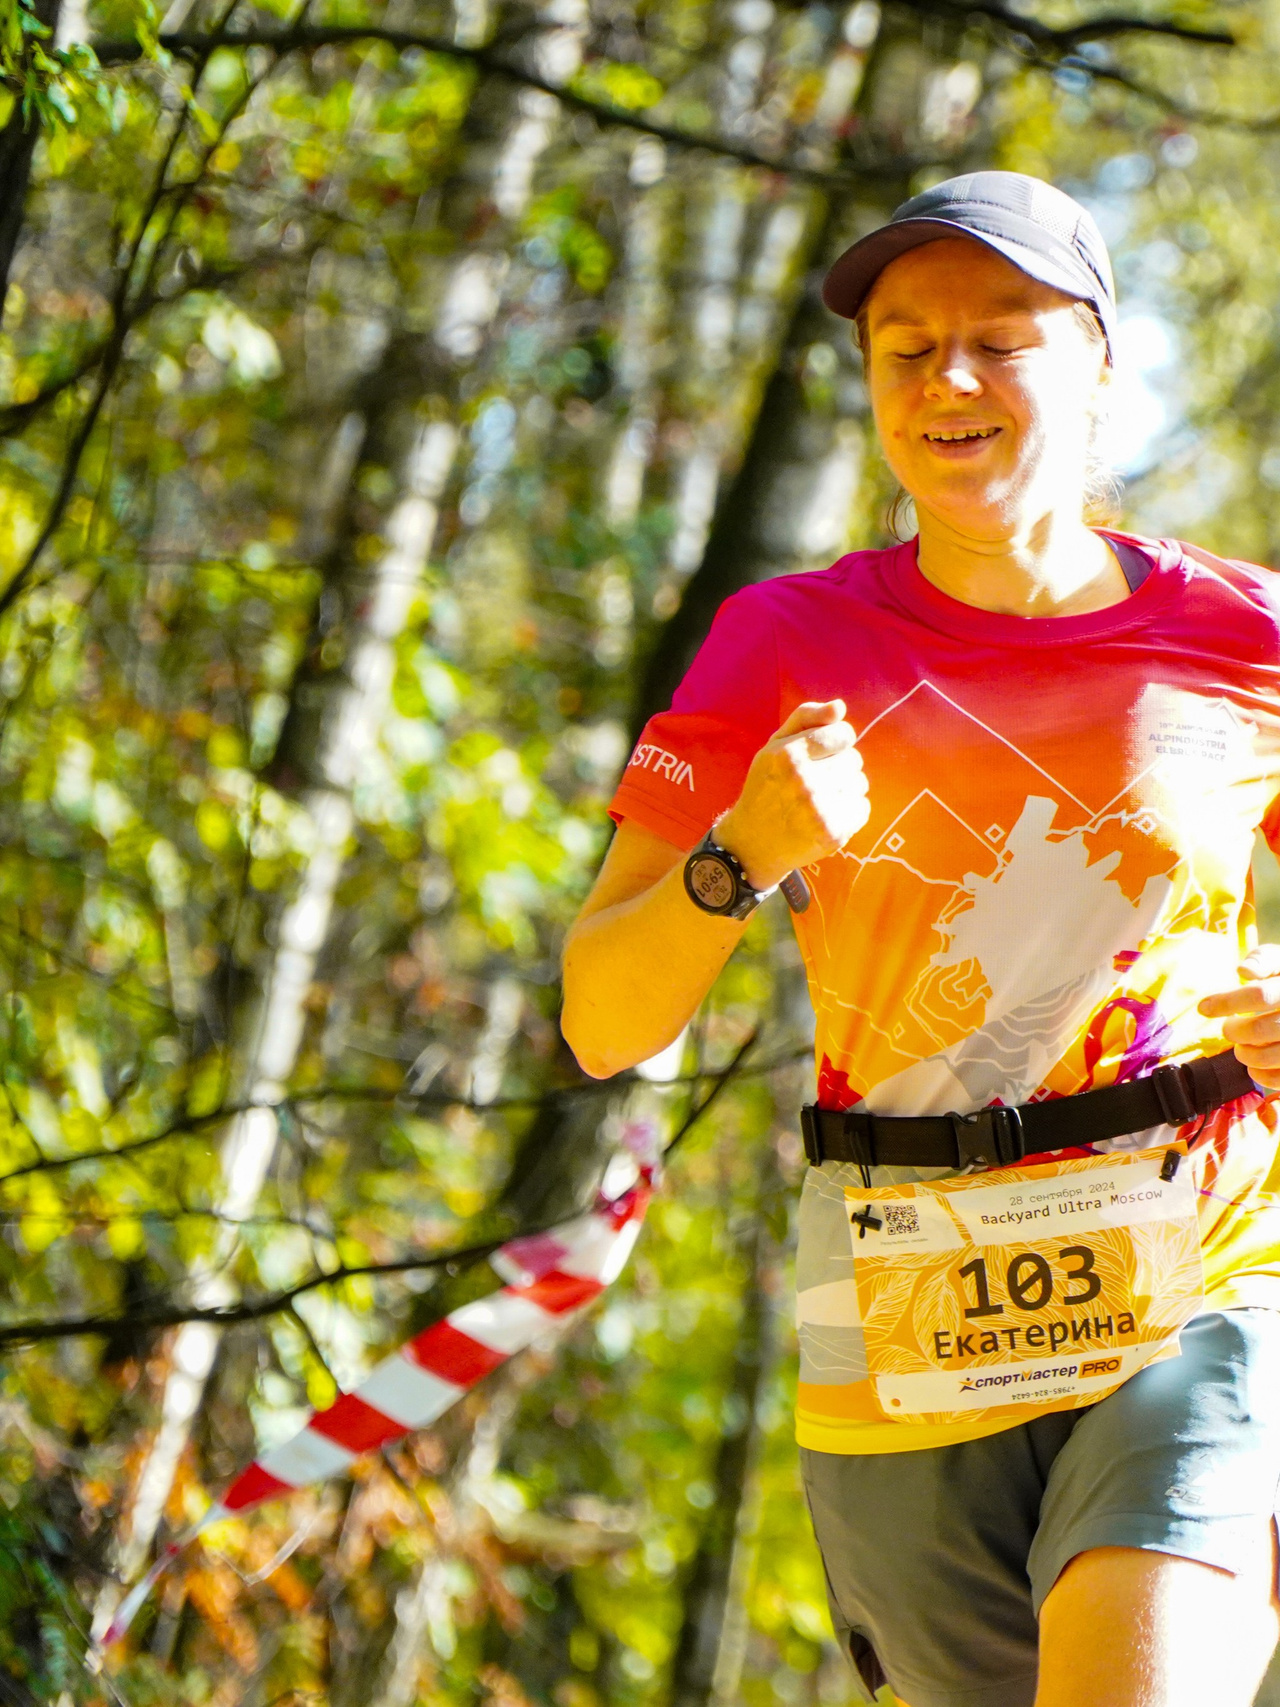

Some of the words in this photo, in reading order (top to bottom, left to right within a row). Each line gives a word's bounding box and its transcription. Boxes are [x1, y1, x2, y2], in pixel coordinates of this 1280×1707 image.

[696, 867, 724, 898] 59:01
[980, 1205, 1051, 1226] Backyard
[1058, 1199, 1102, 1215] Ultra
[1110, 1189, 1163, 1206] Moscow
[1009, 1196, 1024, 1207] 28
[1029, 1188, 1083, 1204] сентября
[1089, 1181, 1116, 1195] 2024
[957, 1245, 1102, 1319] 103
[933, 1311, 1136, 1360] Екатерина
[1081, 1359, 1120, 1376] PRO
